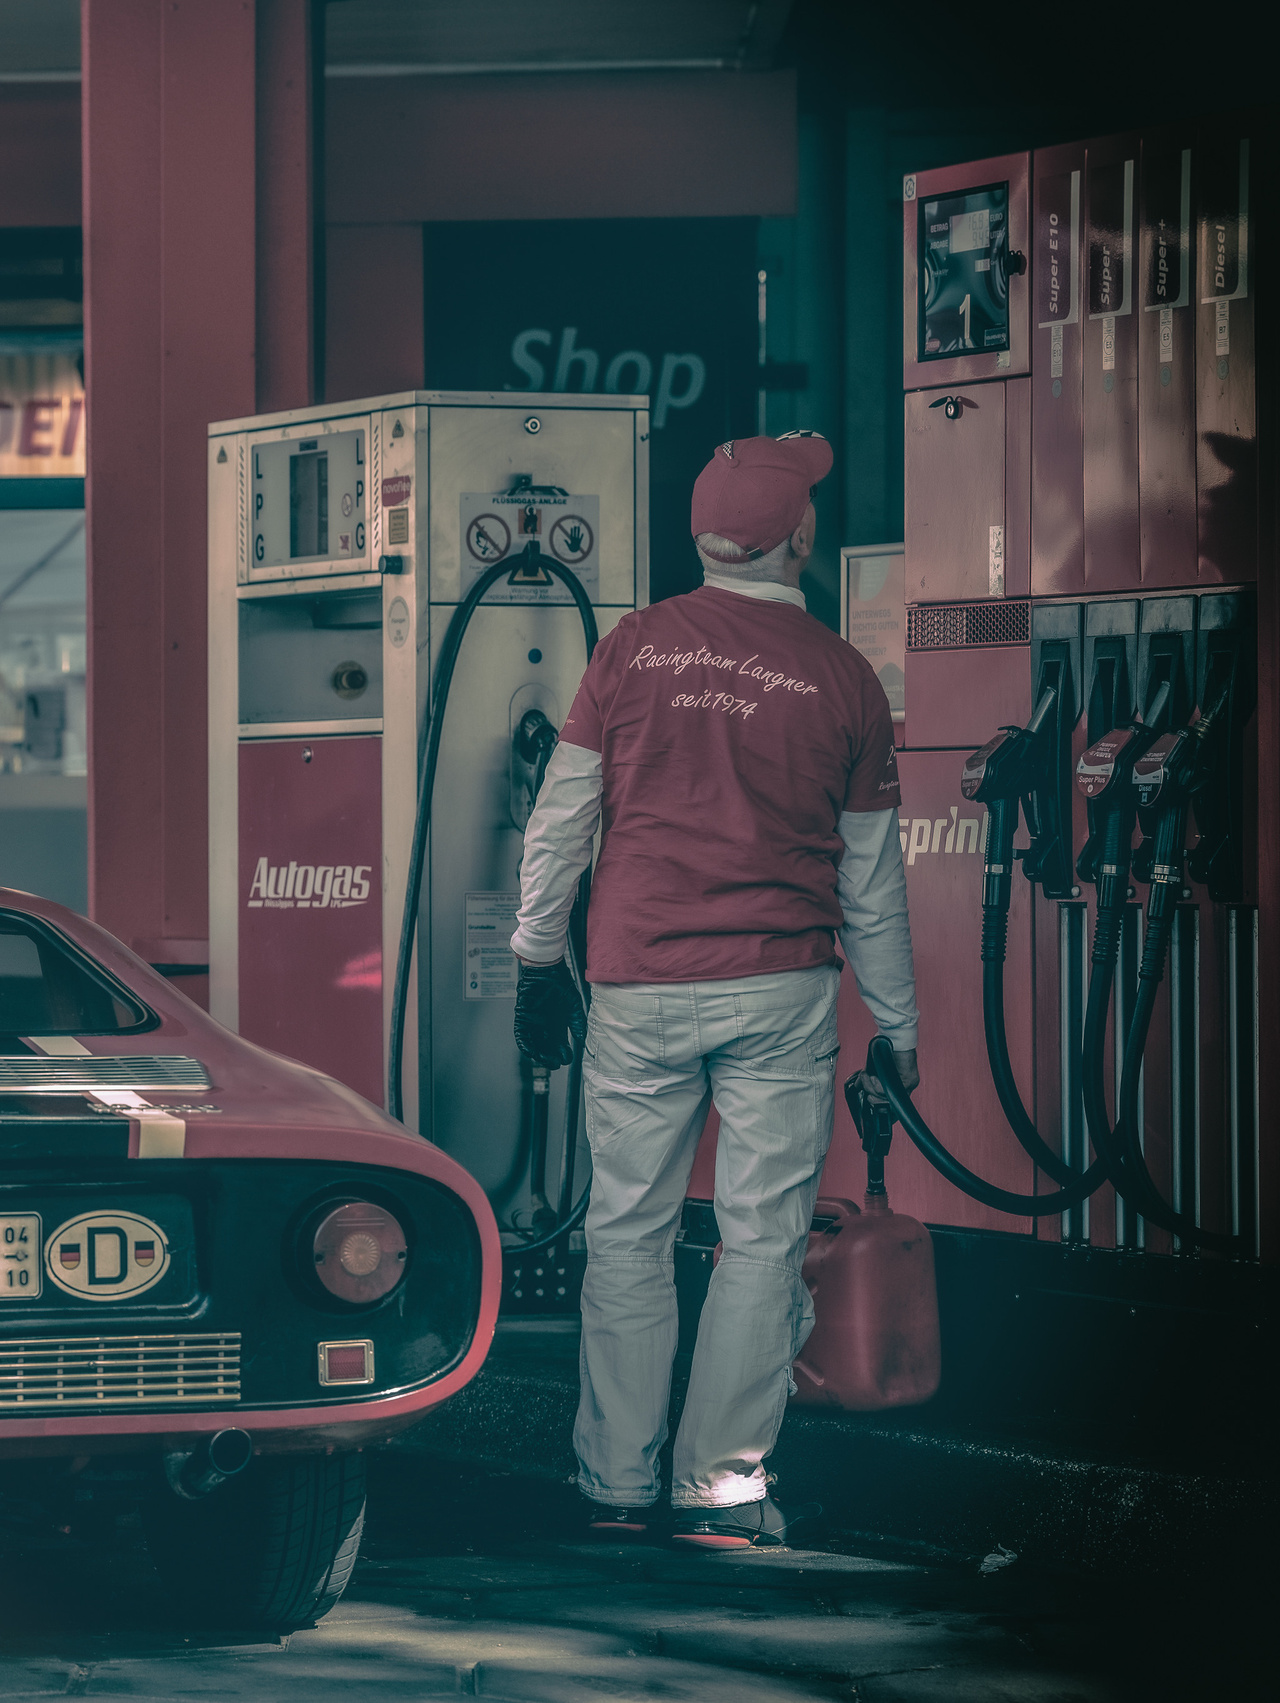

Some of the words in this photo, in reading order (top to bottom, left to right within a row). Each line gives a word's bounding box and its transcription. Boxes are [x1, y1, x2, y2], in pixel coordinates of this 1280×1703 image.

[1049, 212, 1060, 251] E10
[1214, 225, 1226, 289] Diesel
[1049, 255, 1060, 314] Super
[1100, 246, 1113, 305] Super
[1157, 237, 1169, 297] Super
[959, 293, 971, 340] 1
[503, 326, 706, 429] Shop
[852, 608, 891, 620] UNTERWEGS
[852, 622, 877, 633] RICHTIG
[878, 620, 899, 631] GUTEN
[629, 644, 735, 675] Racingteam
[738, 655, 818, 696] Langner
[1079, 775, 1094, 785] Super
[1094, 775, 1106, 784] Plus
[1138, 784, 1153, 792] Diesel
[249, 856, 372, 908] Autogas
[87, 1226, 129, 1286] D
